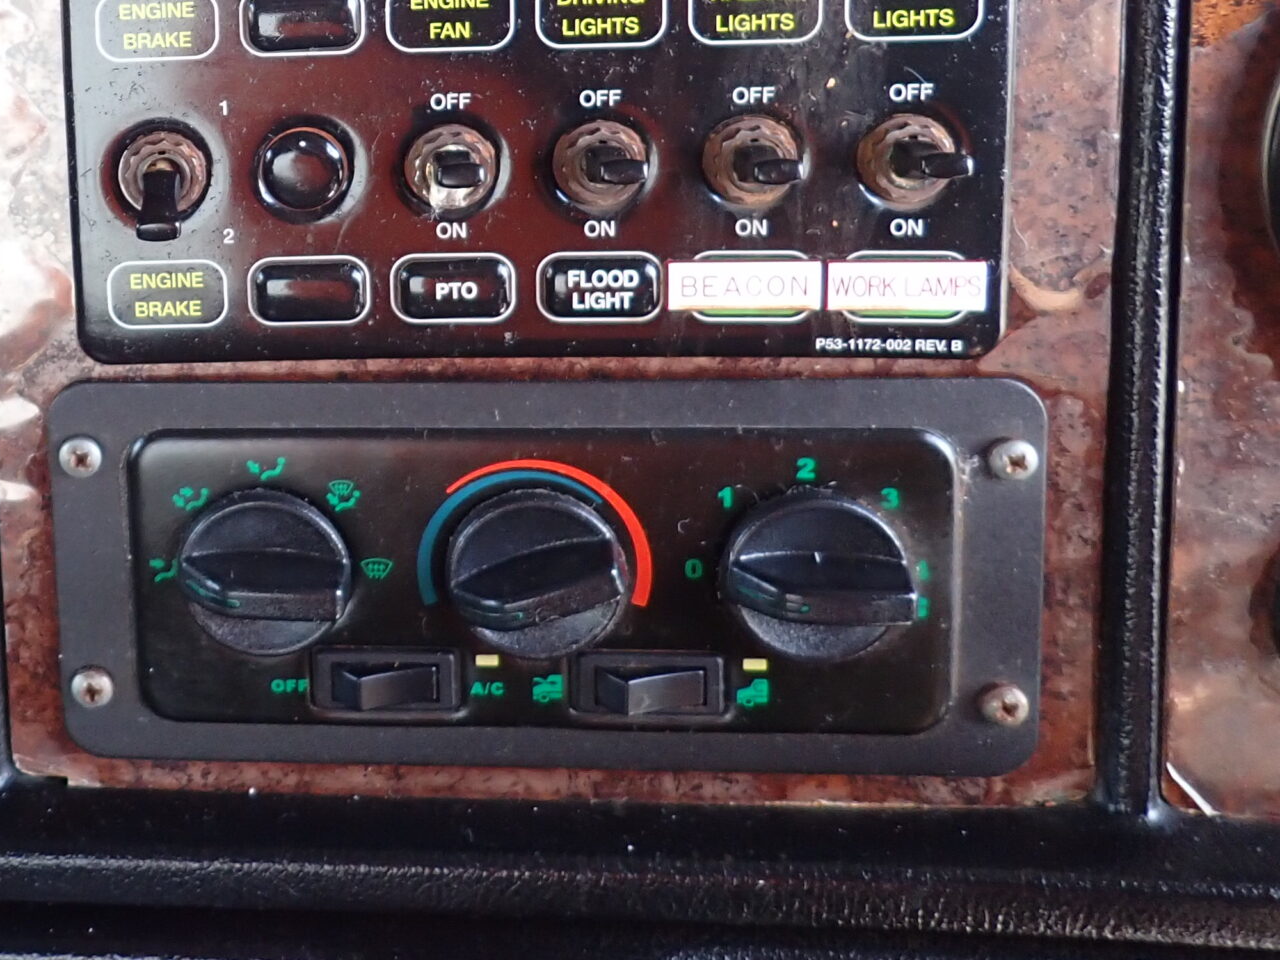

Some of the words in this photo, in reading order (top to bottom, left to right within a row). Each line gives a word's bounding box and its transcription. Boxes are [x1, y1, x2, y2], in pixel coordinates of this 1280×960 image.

[118, 2, 195, 21] ENGINE
[872, 7, 955, 29] LIGHTS
[429, 22, 471, 40] FAN
[562, 16, 640, 36] LIGHTS
[715, 12, 795, 32] LIGHTS
[122, 30, 193, 50] BRAKE
[430, 92, 472, 111] OFF
[579, 89, 622, 108] OFF
[732, 86, 775, 105] OFF
[889, 83, 934, 102] OFF
[219, 99, 229, 117] 1
[223, 228, 235, 245] 2
[436, 222, 468, 240] ON
[583, 220, 616, 238] ON
[735, 219, 768, 237] ON
[890, 219, 923, 237] ON
[130, 272, 204, 289] ENGINE
[567, 270, 639, 289] FLOOD
[681, 275, 808, 297] BEACON
[832, 275, 897, 297] WORK
[905, 274, 982, 297] LAMPS
[435, 283, 478, 300] PTO
[135, 300, 202, 317] BRAKE
[572, 292, 632, 311] LIGHT
[815, 338, 912, 351] P53-1172-002
[915, 339, 948, 351] REV.
[951, 340, 963, 352] B
[796, 458, 817, 480] 2
[717, 487, 733, 508] 1
[881, 488, 900, 509] 3
[685, 559, 703, 579] 0
[271, 679, 308, 692] OFF
[471, 681, 504, 695] A/C
